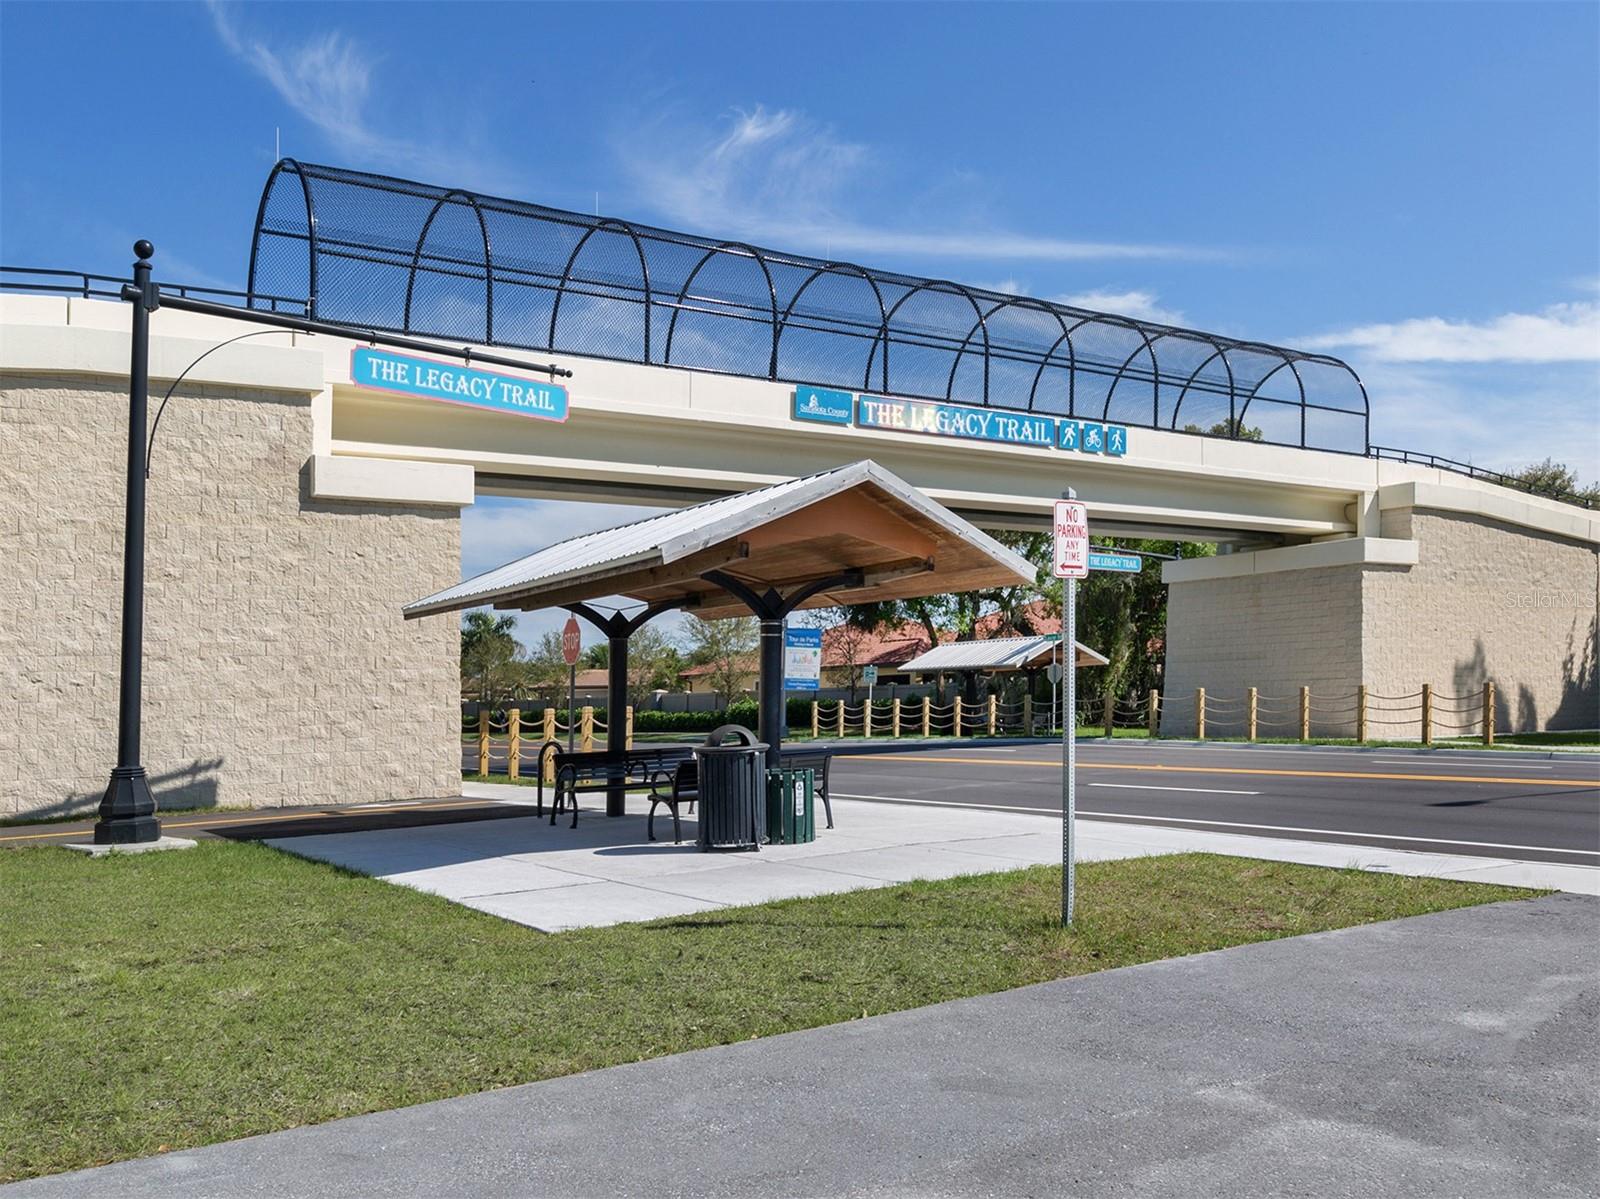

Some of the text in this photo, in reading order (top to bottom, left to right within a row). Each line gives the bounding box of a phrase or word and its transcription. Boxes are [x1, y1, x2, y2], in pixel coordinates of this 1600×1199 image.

[367, 357, 555, 412] THE LEGACY TRAIL
[863, 400, 1051, 443] THE LEGACY TRAIL
[1065, 508, 1079, 524] NO
[1057, 523, 1086, 540] PARKING
[1065, 541, 1079, 551] ANY
[1064, 551, 1080, 562] TIME
[1090, 556, 1101, 566] THE
[1122, 559, 1138, 569] TRAIL
[564, 632, 579, 650] STOP
